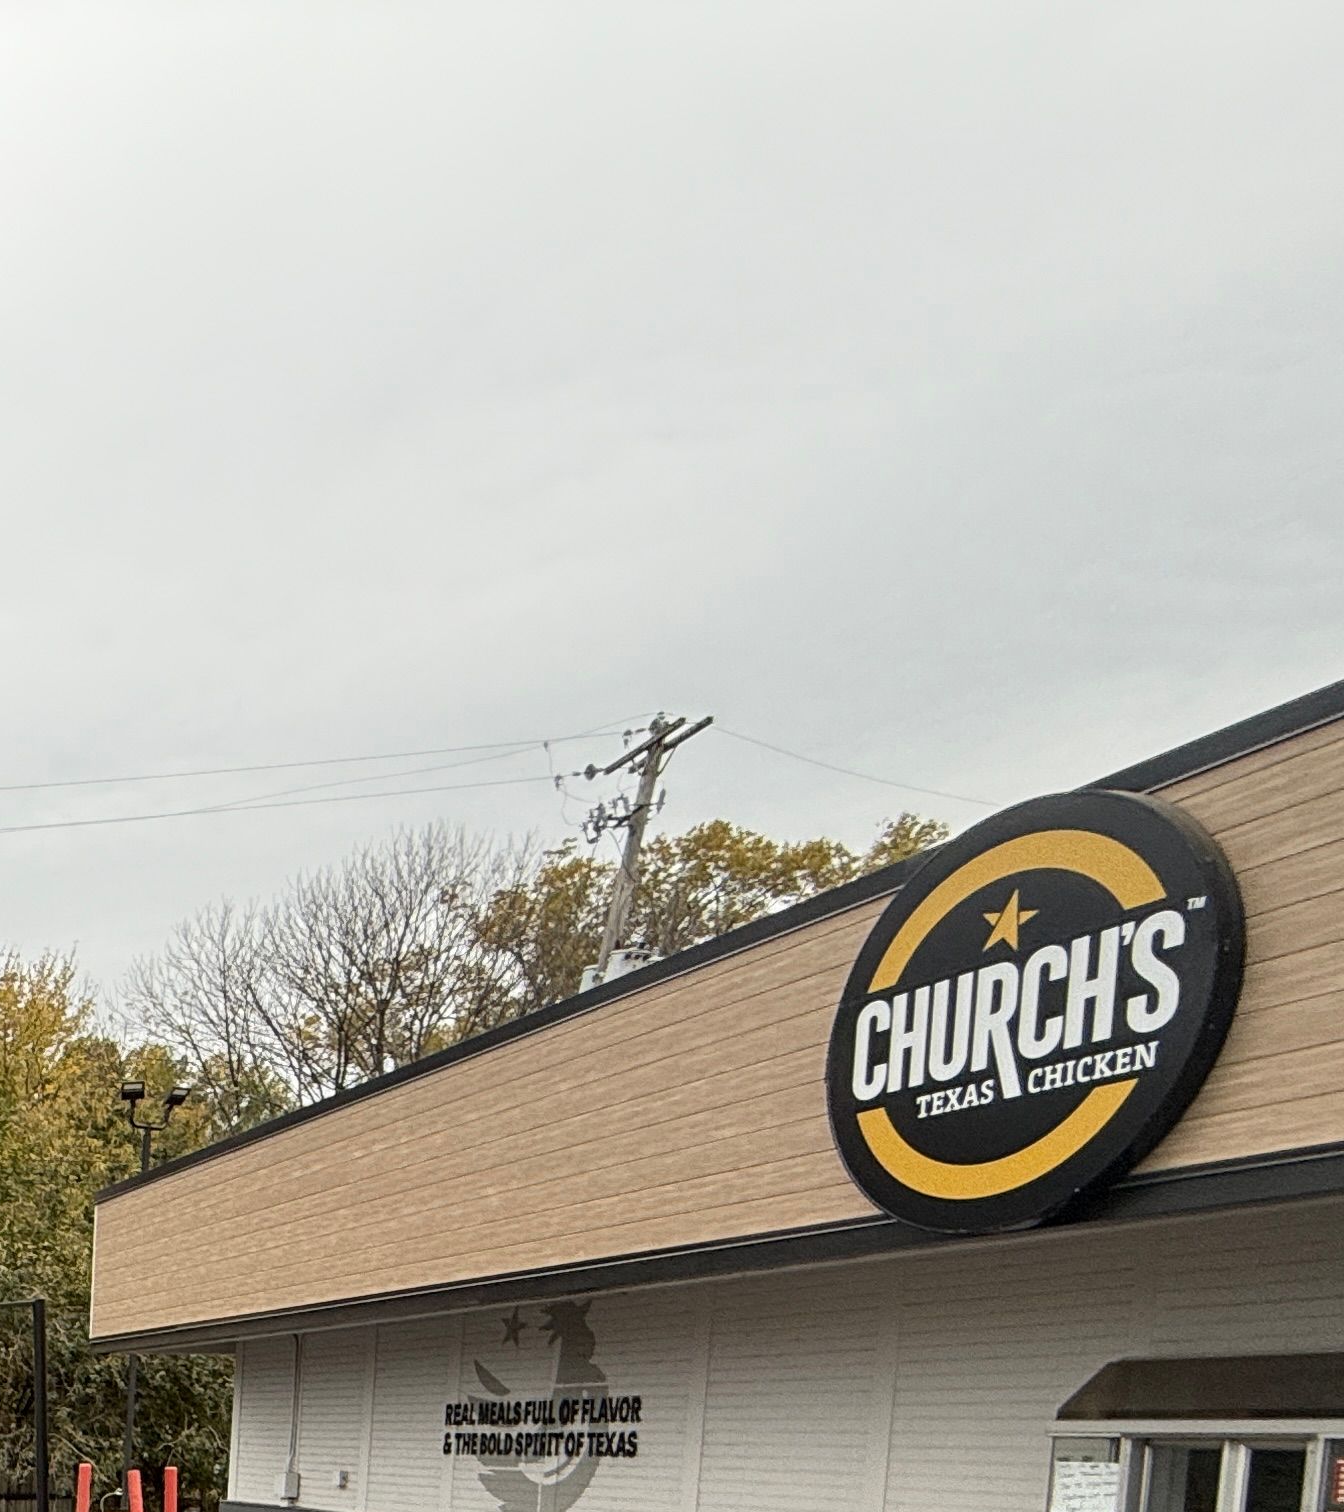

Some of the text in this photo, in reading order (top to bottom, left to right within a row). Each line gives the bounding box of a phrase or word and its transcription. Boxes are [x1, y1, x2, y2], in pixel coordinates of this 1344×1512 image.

[852, 909, 1185, 1100] CHURCH'S
[916, 1041, 1160, 1119] TEXAS CHICKEN
[445, 1395, 642, 1426] REAL MEALS FULL OF FLAVOR
[443, 1431, 638, 1458] & THE BOLD SPIRIT OF TEXAS
